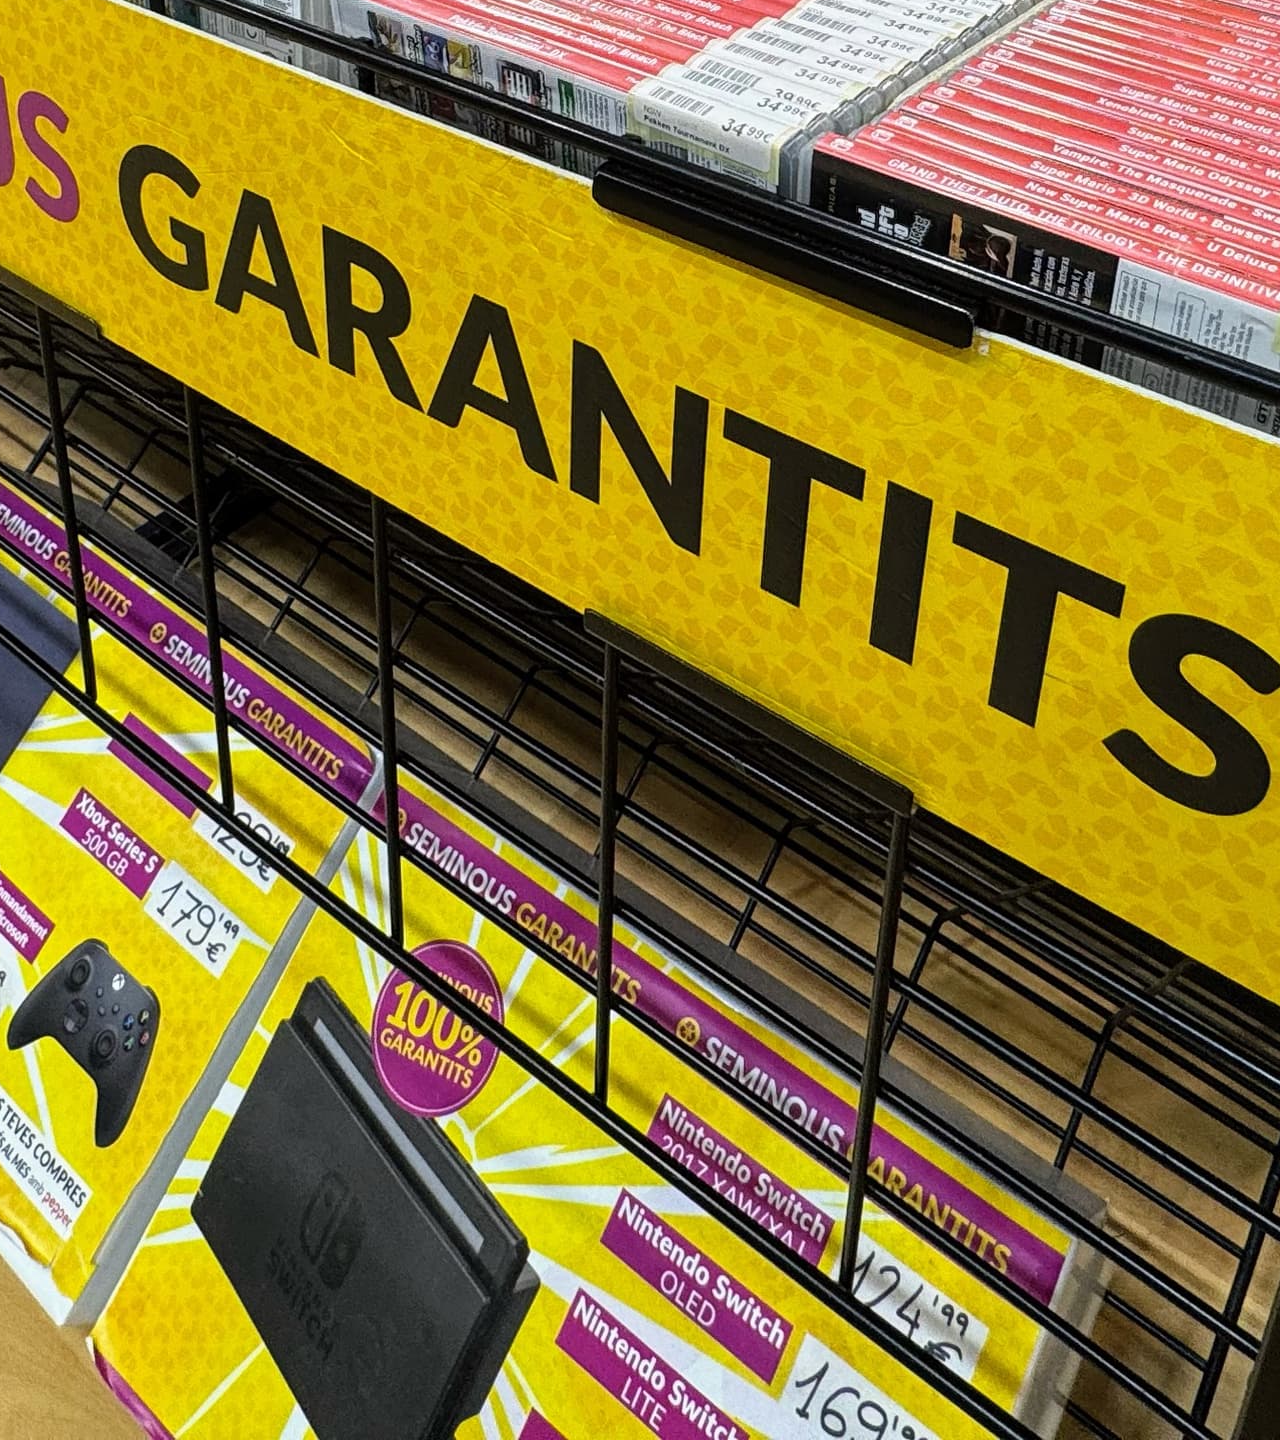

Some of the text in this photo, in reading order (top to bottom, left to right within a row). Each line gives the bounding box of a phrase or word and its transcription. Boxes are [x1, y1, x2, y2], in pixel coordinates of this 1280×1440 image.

[887, 158, 937, 182] GRAND
[938, 175, 987, 204] THEFT
[1034, 209, 1068, 230] THE
[1070, 218, 1139, 253] TRILOGY
[1156, 245, 1187, 270] THE
[1024, 180, 1058, 200] New
[1060, 190, 1103, 214] Super
[1105, 206, 1150, 231] Mario
[1206, 238, 1219, 252] U
[1221, 243, 1280, 274] Deluxe
[53, 550, 133, 619] GAANTITS
[247, 697, 346, 781] GARANTITS
[75, 790, 157, 875] Xbox Series S
[79, 826, 129, 877] 500 GB
[403, 822, 519, 914] SEMINOUS
[514, 901, 643, 1006] GARANTTS
[380, 1029, 475, 1090] GARANTITS
[386, 978, 483, 1069] 100%
[0, 1105, 36, 1149] TEVES
[32, 1143, 87, 1209] COMPRES
[660, 1098, 751, 1185] Nintendo
[755, 1172, 828, 1244] Switch
[703, 1037, 848, 1152] SEMINOUS
[846, 1140, 1012, 1274] ARANTITS
[618, 1195, 712, 1286] Nintendo
[713, 1277, 787, 1351] Switch
[659, 1269, 717, 1329] OLED
[573, 1296, 667, 1392] Nintendo
[620, 1378, 668, 1432] LITE
